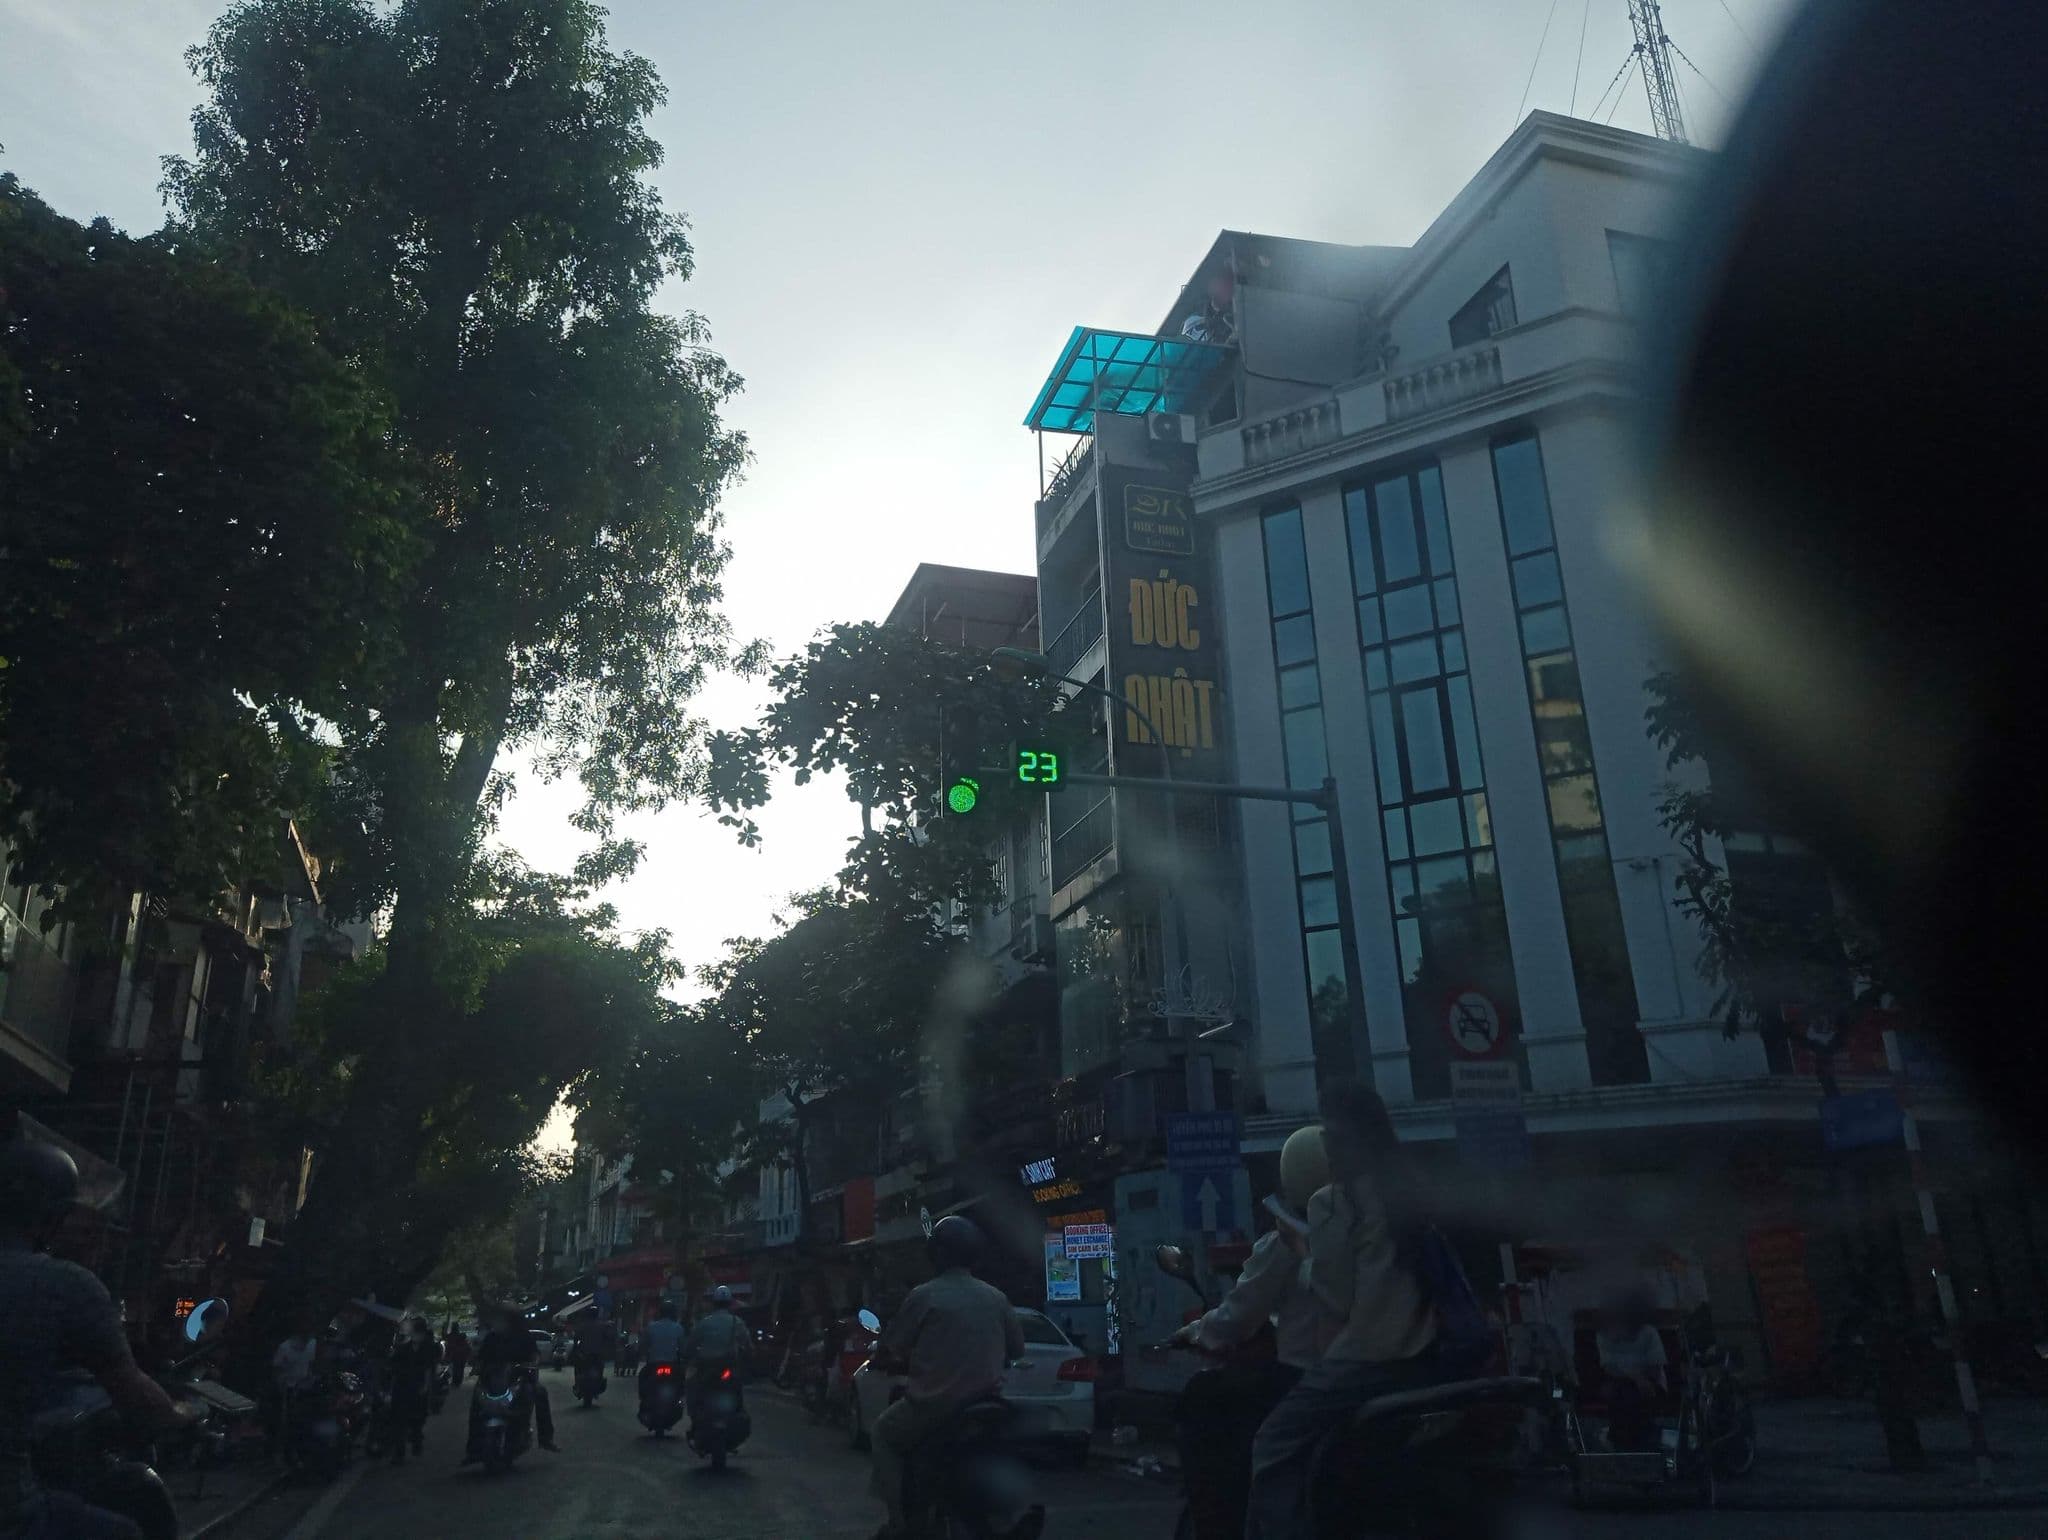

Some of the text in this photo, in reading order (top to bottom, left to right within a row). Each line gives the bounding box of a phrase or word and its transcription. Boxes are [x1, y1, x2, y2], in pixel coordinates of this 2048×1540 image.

[1128, 568, 1201, 650] ĐỨC
[1125, 667, 1214, 758] NHẬT
[1019, 751, 1057, 782] 23
[1065, 1224, 1107, 1236] BOOKING OFFICE
[1066, 1236, 1082, 1245] MONEY
[1084, 1234, 1108, 1244] EXCHANGE
[1078, 1245, 1092, 1253] CARD
